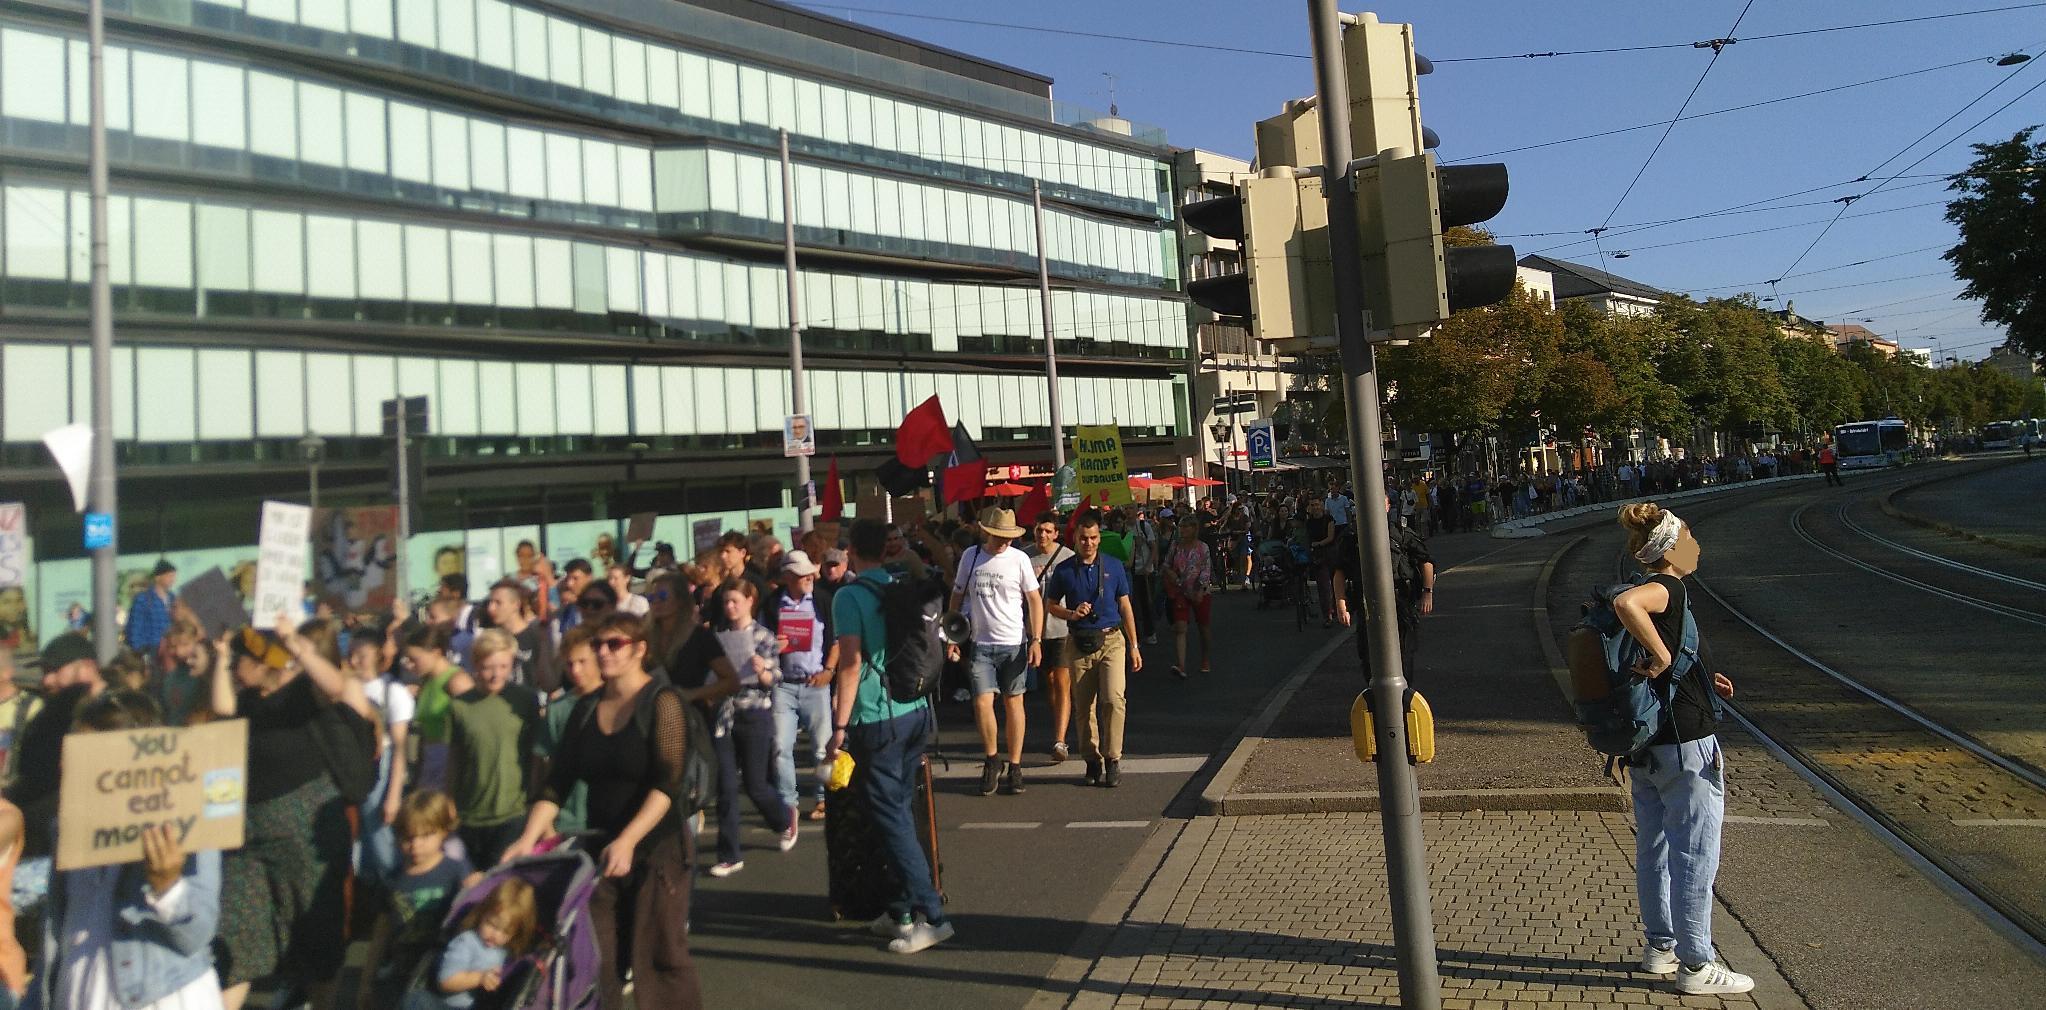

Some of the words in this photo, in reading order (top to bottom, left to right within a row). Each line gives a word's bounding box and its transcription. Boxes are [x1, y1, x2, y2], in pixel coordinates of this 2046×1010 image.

[1255, 435, 1264, 454] P
[1080, 456, 1119, 471] KAMPF
[975, 569, 1004, 580] Climate
[96, 752, 197, 794] cannot
[128, 788, 175, 814] eat
